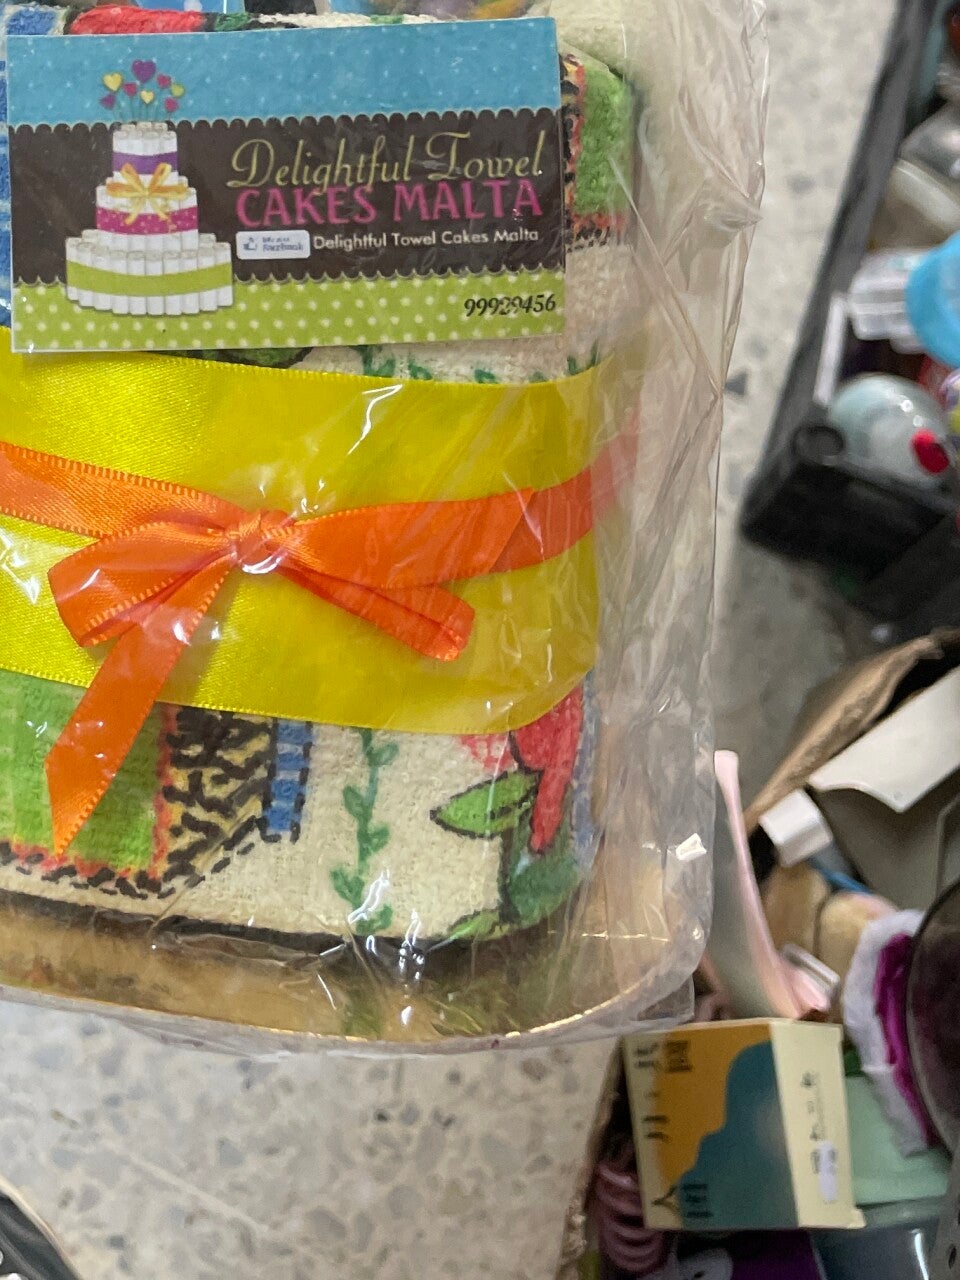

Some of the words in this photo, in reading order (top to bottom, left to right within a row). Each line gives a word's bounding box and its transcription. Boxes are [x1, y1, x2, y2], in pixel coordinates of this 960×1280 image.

[226, 134, 415, 196] Delightful
[425, 129, 546, 181] Towel
[235, 184, 378, 228] CAKES
[392, 178, 543, 221] MALTA
[312, 232, 387, 251] Delightful
[391, 230, 437, 246] Towel
[441, 229, 489, 245] Cakes
[493, 226, 539, 243] Malta
